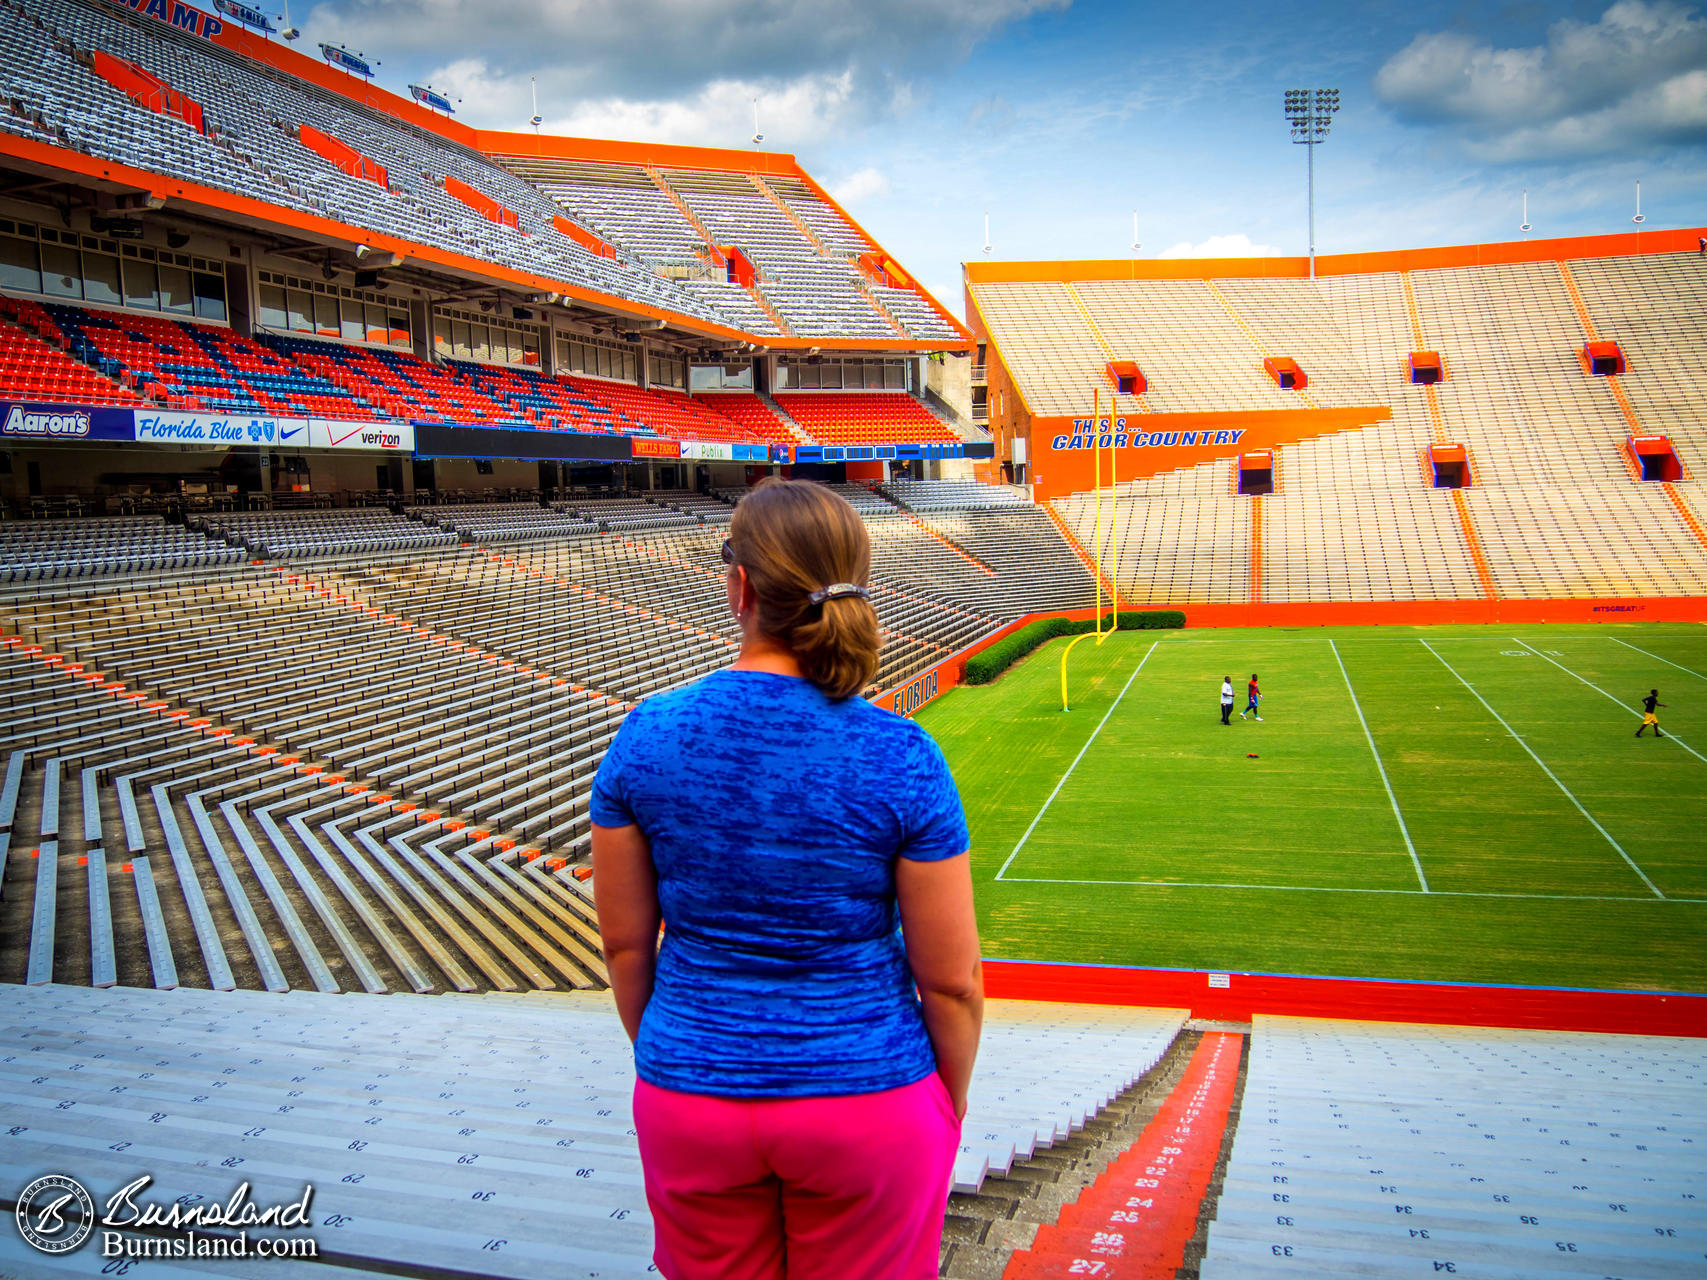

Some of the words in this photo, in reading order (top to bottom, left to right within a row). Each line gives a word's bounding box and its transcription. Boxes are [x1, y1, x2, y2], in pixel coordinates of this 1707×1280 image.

[4, 406, 90, 435] Aaron's
[140, 416, 206, 438] Florida
[209, 420, 243, 440] Blue
[361, 430, 400, 448] verizon
[1051, 432, 1129, 450] GATOR
[1132, 429, 1247, 448] COUNTRY
[635, 442, 658, 453] WELLS
[659, 443, 679, 455] FARGO
[701, 444, 723, 458] Publix
[893, 670, 938, 718] FLORIDA
[57, 1101, 77, 1110] 25
[149, 1113, 167, 1122] 26
[5, 1127, 28, 1135] 26
[244, 1128, 266, 1136] 27
[109, 1142, 132, 1151] 27
[348, 1141, 368, 1151] 28
[221, 1157, 244, 1167] 28
[458, 1154, 479, 1163] 29
[576, 1169, 594, 1178] 30
[1145, 1166, 1167, 1176] 22
[342, 1174, 365, 1183] 29
[1135, 1178, 1159, 1188] 23
[472, 1192, 496, 1201] 30
[1273, 1194, 1289, 1202] 33
[1493, 1195, 1510, 1203] 35
[1126, 1197, 1153, 1208] 24
[1395, 1205, 1412, 1214] 34
[1609, 1204, 1627, 1212] 36
[610, 1209, 630, 1219] 31
[1110, 1211, 1139, 1223] 25
[324, 1215, 351, 1227] 30
[1277, 1217, 1293, 1226] 33
[1520, 1216, 1538, 1225] 35
[1409, 1229, 1429, 1238] 34
[1655, 1228, 1676, 1237] 36
[1091, 1232, 1125, 1246] 26
[483, 1240, 507, 1250] 31
[1556, 1242, 1577, 1252] 35
[1272, 1246, 1293, 1256] 33
[102, 1259, 138, 1275] 30
[1068, 1259, 1106, 1275] 27
[1434, 1261, 1456, 1273] 34
